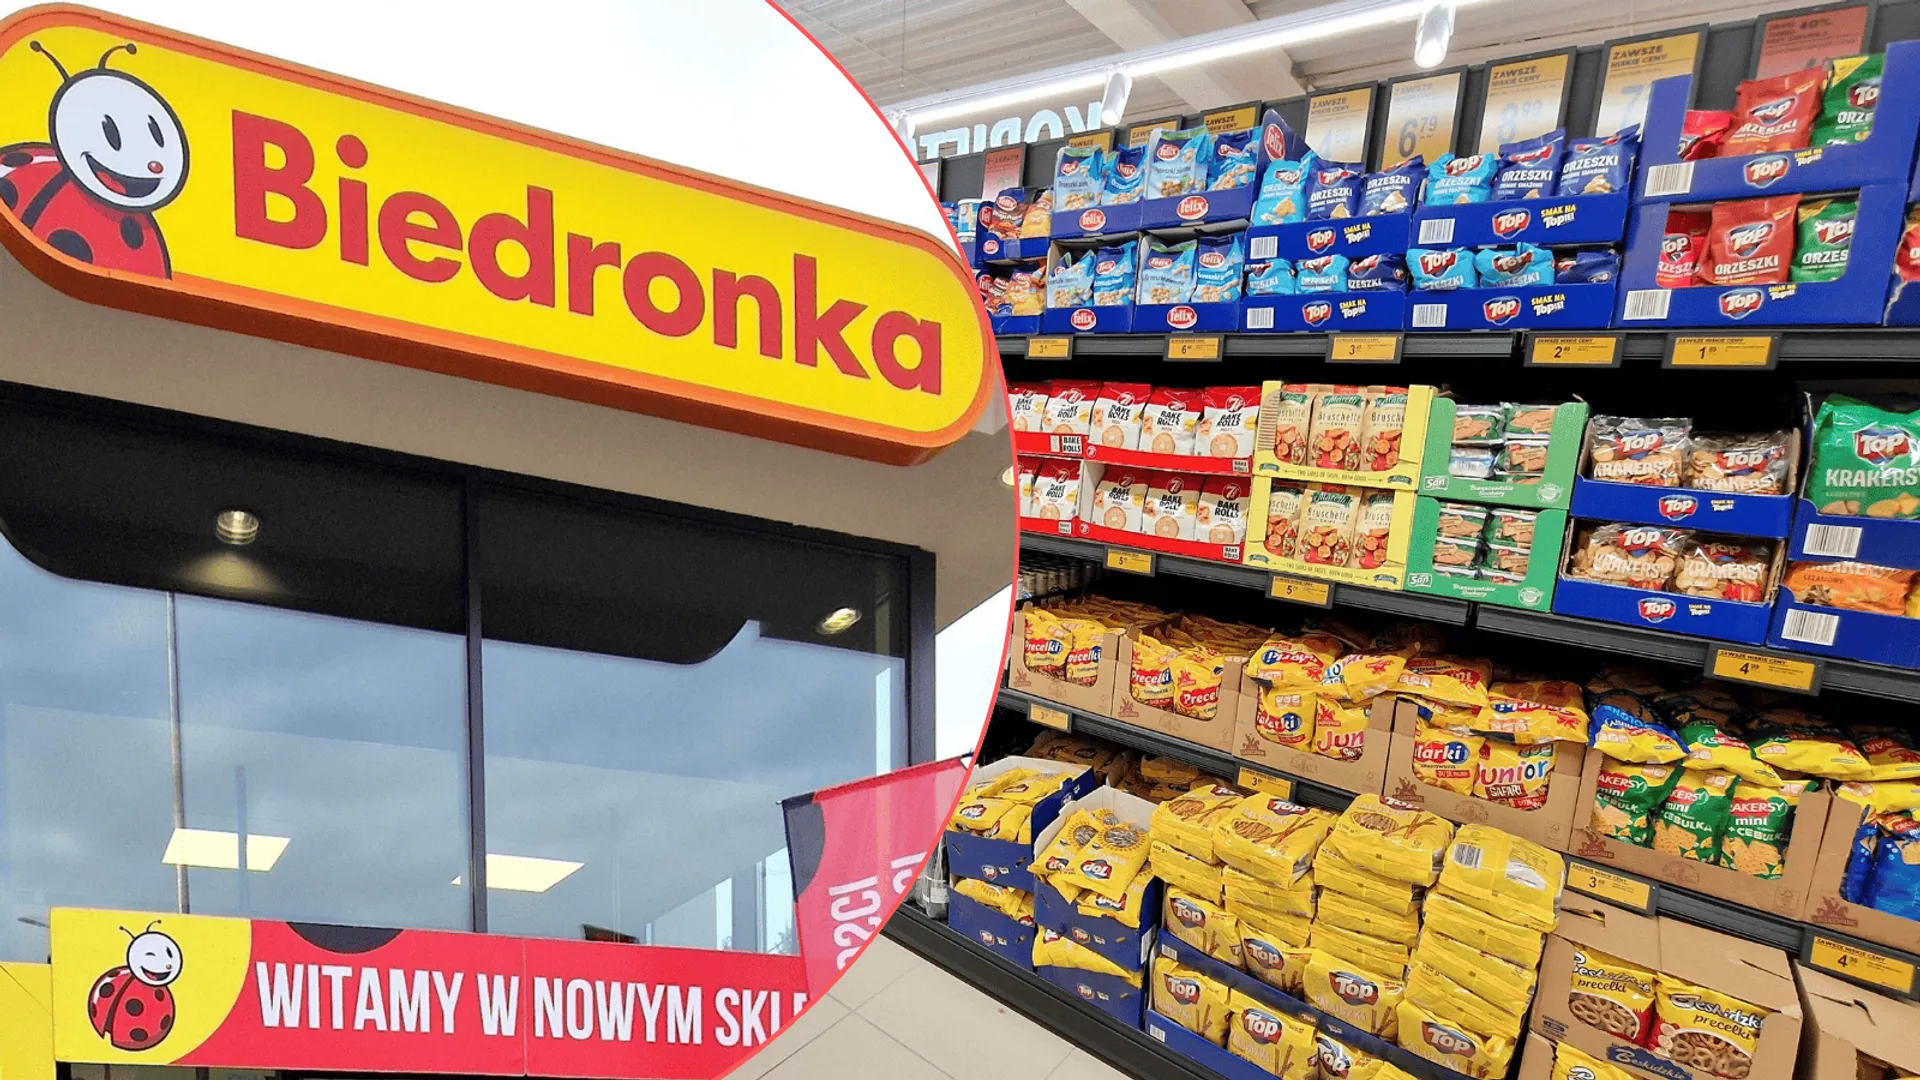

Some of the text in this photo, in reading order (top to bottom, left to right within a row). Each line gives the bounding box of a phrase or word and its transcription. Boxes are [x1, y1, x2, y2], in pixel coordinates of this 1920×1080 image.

[1612, 45, 1663, 60] ZAWSZE
[1610, 54, 1668, 68] NISKIE CENY
[1492, 66, 1537, 80] ZAWSZE
[1518, 75, 1540, 83] CENY
[1394, 84, 1433, 95] ZAWSZE
[1312, 97, 1347, 109] ZAWSZE
[1206, 115, 1235, 126] ZAWSZE
[1399, 116, 1438, 158] 6 79
[1563, 155, 1619, 173] ORZESZKI
[1367, 175, 1411, 189] ORZESZKI
[1502, 170, 1553, 182] ORZESZKI
[1435, 176, 1481, 189] ORZESZKI
[1311, 187, 1353, 201] ORZESZKI
[1179, 198, 1206, 216] felix
[1541, 204, 1577, 218] SMAK NA
[1081, 211, 1104, 228] felix
[1344, 225, 1363, 234] SMAK
[231, 109, 943, 396] Biedronka
[1715, 256, 1779, 275] ORZESZKI
[1531, 294, 1565, 306] SMAK NA
[1073, 311, 1095, 326] felix
[1169, 308, 1196, 324] felix
[1181, 345, 1187, 354] 6
[1349, 344, 1355, 355] 3
[1554, 346, 1563, 358] 2
[1699, 346, 1706, 359] 1
[1160, 411, 1181, 419] BAKE
[1220, 413, 1242, 421] BAKE
[1318, 411, 1361, 421] Bruschette
[1216, 419, 1241, 428] ROLLS
[1063, 436, 1080, 445] BAKE
[1063, 444, 1082, 453] ROLLS
[1425, 477, 1446, 489] San
[1161, 495, 1182, 503] BAKE
[1217, 501, 1240, 510] BAKE
[1214, 509, 1239, 518] ROLLS
[1307, 508, 1350, 521] Bruschette
[1119, 556, 1124, 565] 5
[1685, 561, 1767, 580] KRAKERSY
[1410, 574, 1429, 586] San
[1286, 585, 1292, 594] 5
[1025, 640, 1062, 655] Precelki
[1719, 650, 1746, 659] ZAWSZE
[1739, 663, 1750, 675] 4
[1131, 669, 1170, 684] Precelki
[1317, 730, 1364, 752] Jun
[1252, 777, 1258, 786] 3
[1489, 785, 1522, 797] SAFARI
[1665, 801, 1690, 813] mini
[1663, 811, 1713, 833] CEBULKA
[1735, 816, 1768, 826] mini
[1588, 876, 1597, 888] 3
[1837, 954, 1848, 968] 4
[1865, 952, 1885, 963] CENY
[256, 960, 464, 1035] WITAMY
[477, 973, 520, 1037] W
[534, 976, 702, 1047] NOWYM
[1693, 1013, 1753, 1041] precelki
